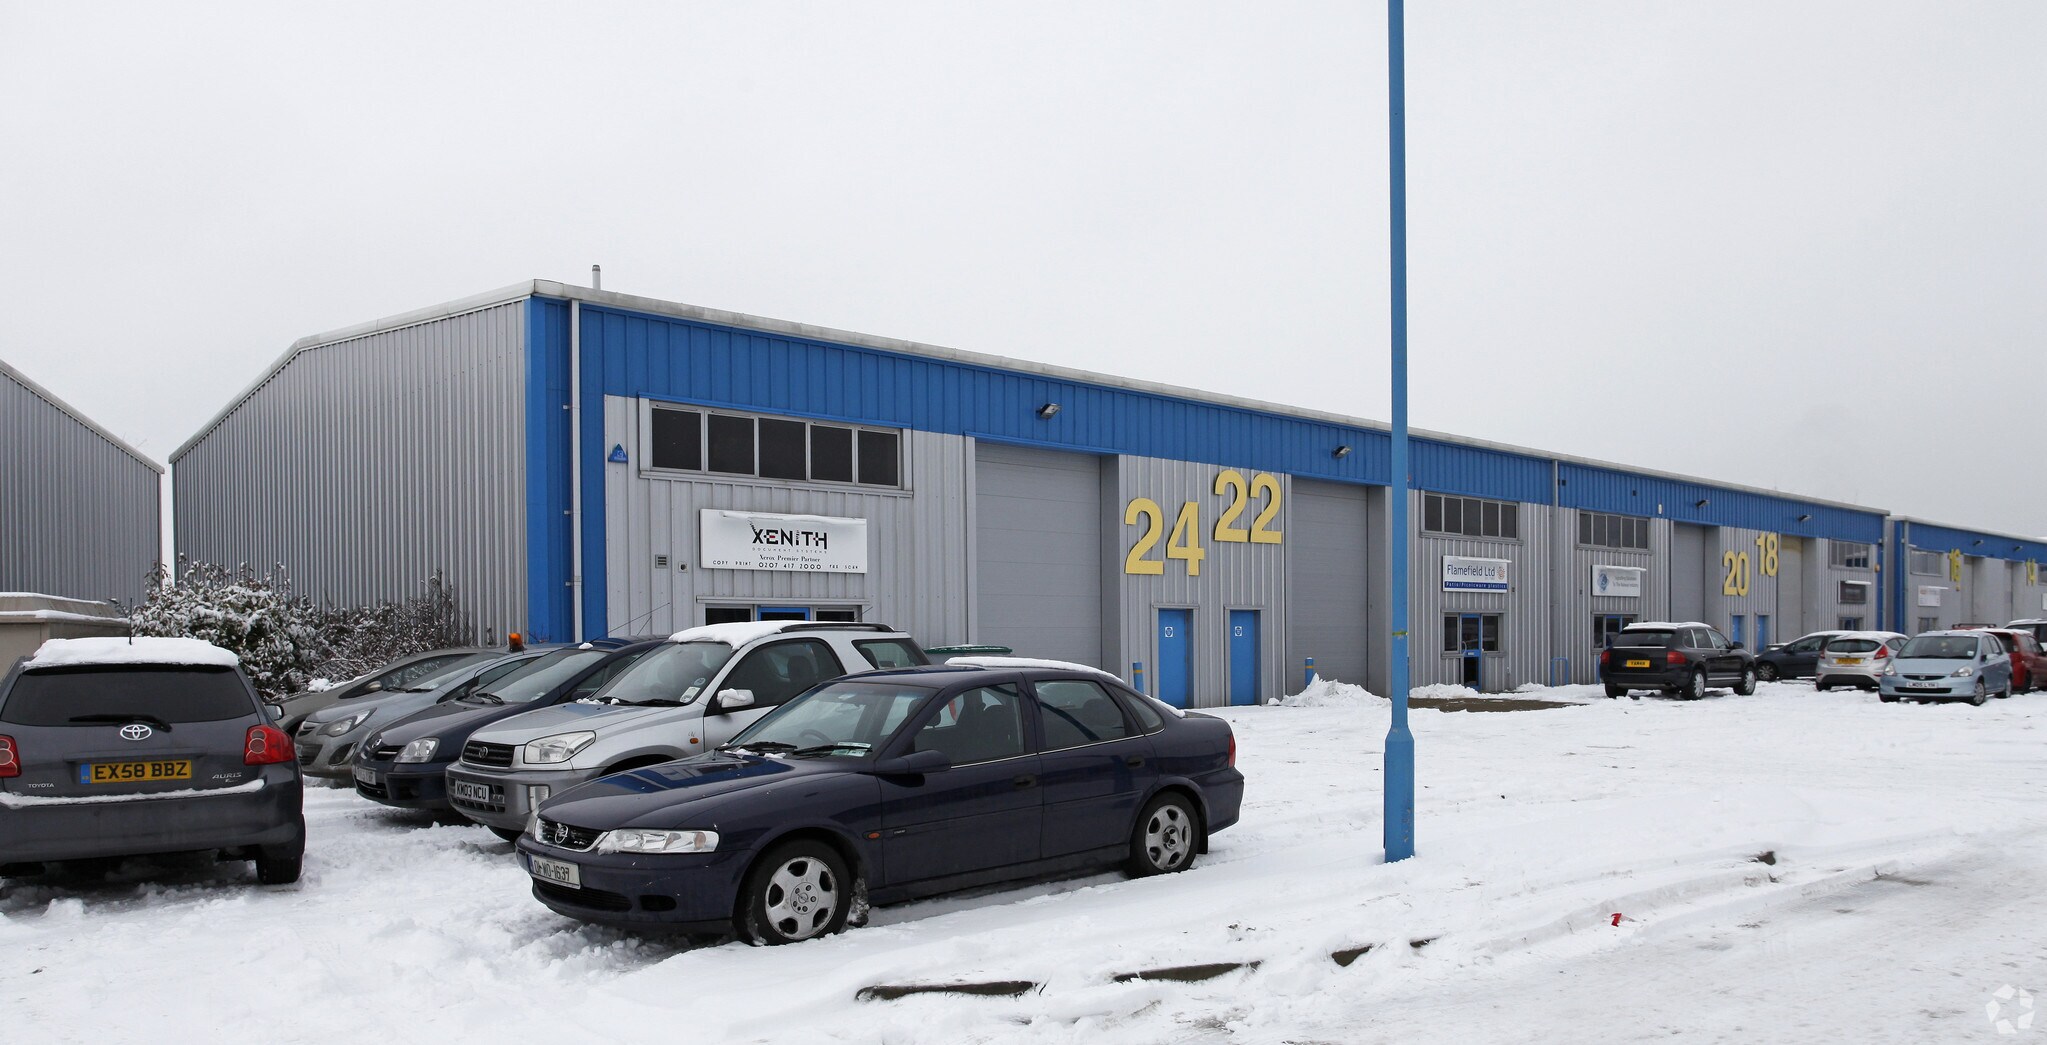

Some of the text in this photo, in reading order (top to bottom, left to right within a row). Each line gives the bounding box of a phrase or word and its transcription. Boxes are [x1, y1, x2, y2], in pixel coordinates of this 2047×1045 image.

[1214, 470, 1282, 544] 22
[751, 526, 828, 550] XENITH
[1125, 498, 1205, 576] 24
[1755, 531, 1779, 577] 18
[1447, 564, 1496, 577] Flamefield Ltd
[1723, 551, 1750, 597] 20
[1949, 548, 1961, 582] 16
[94, 762, 188, 780] EX58 BBZ
[473, 784, 487, 800] NCU
